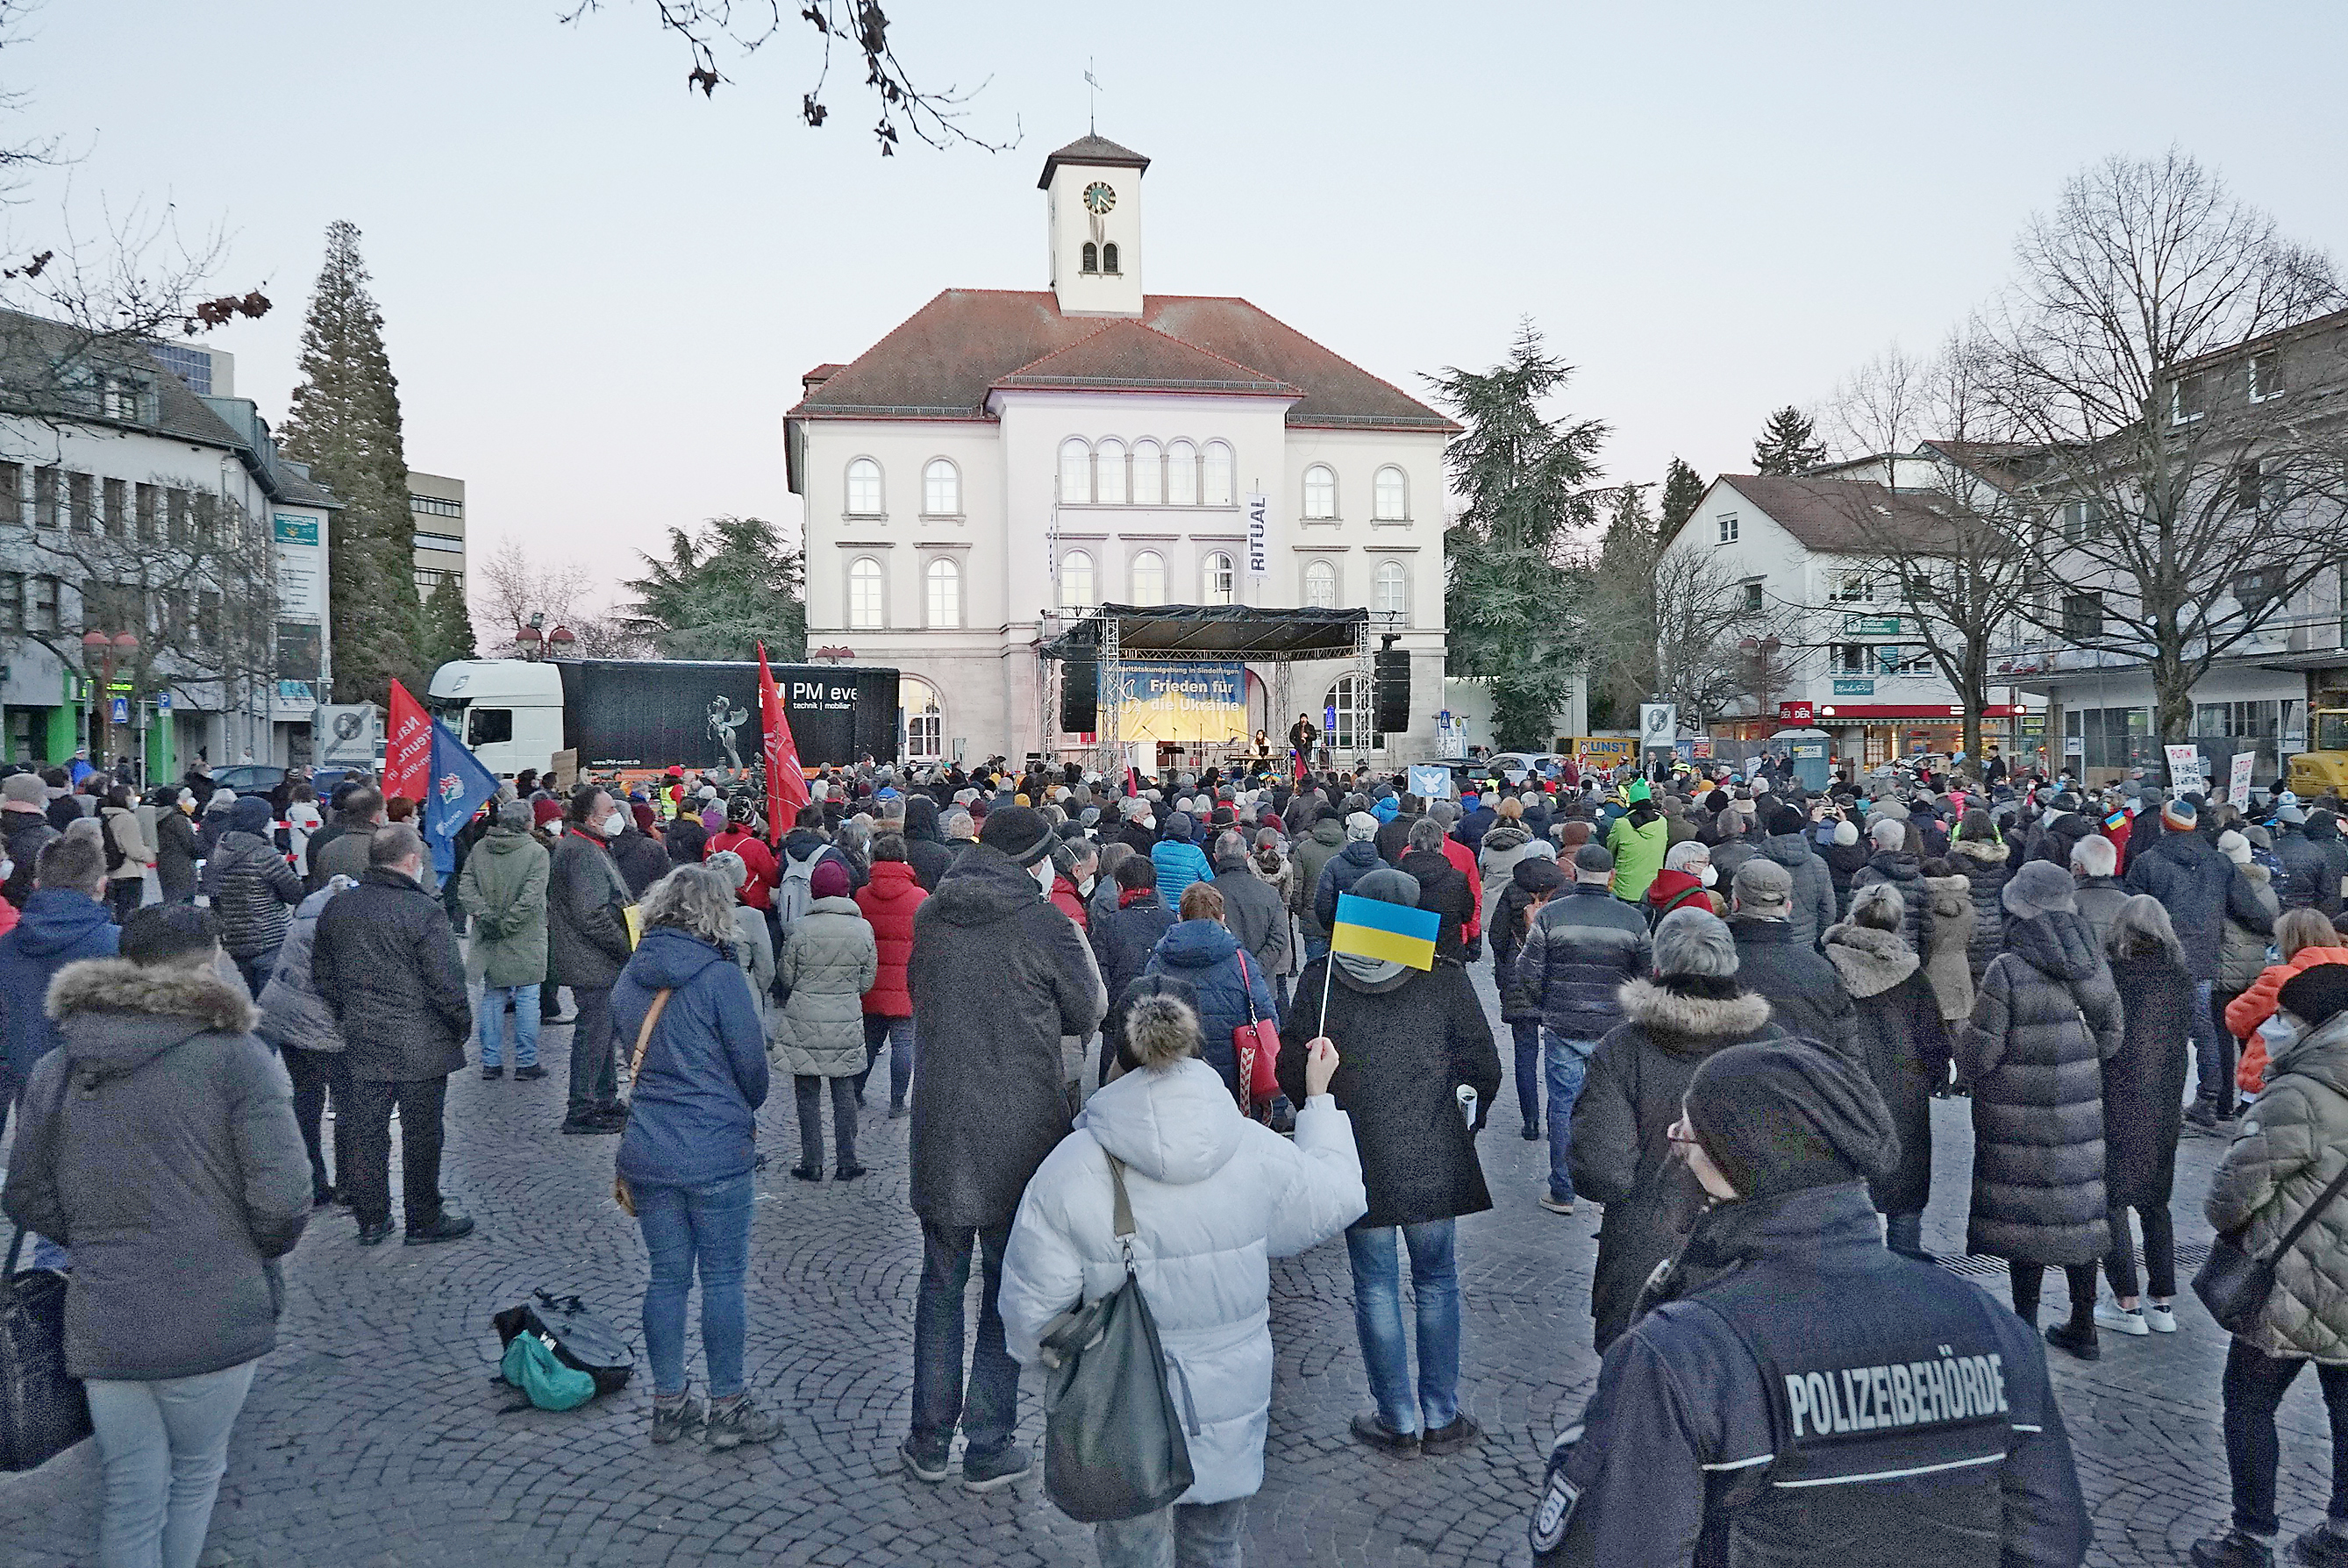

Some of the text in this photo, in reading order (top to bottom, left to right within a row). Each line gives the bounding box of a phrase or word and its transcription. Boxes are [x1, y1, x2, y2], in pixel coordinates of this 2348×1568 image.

[1250, 497, 1266, 571] RITUAL
[793, 682, 824, 700] PM
[1150, 679, 1235, 694] Frieden für
[1150, 699, 1241, 712] die Ukraine
[1795, 707, 1811, 719] DER
[1785, 1343, 2009, 1437] POLIZEIBEHÖRDE
